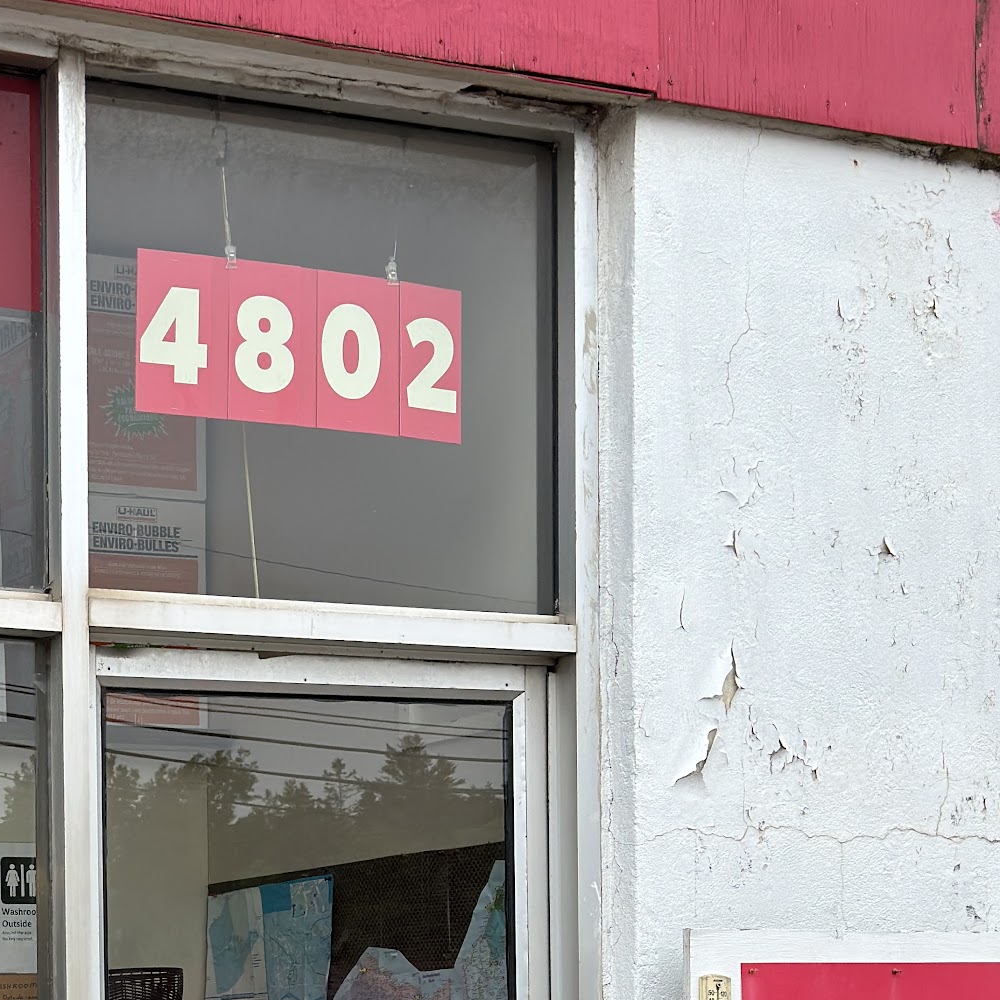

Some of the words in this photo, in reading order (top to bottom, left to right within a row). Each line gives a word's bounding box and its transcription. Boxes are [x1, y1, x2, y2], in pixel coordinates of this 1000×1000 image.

[90, 280, 136, 296] ENVIRO-
[91, 294, 136, 310] ENVIRO-
[140, 287, 457, 413] 4802
[2, 908, 36, 916] Washroo
[2, 920, 32, 928] Outside
